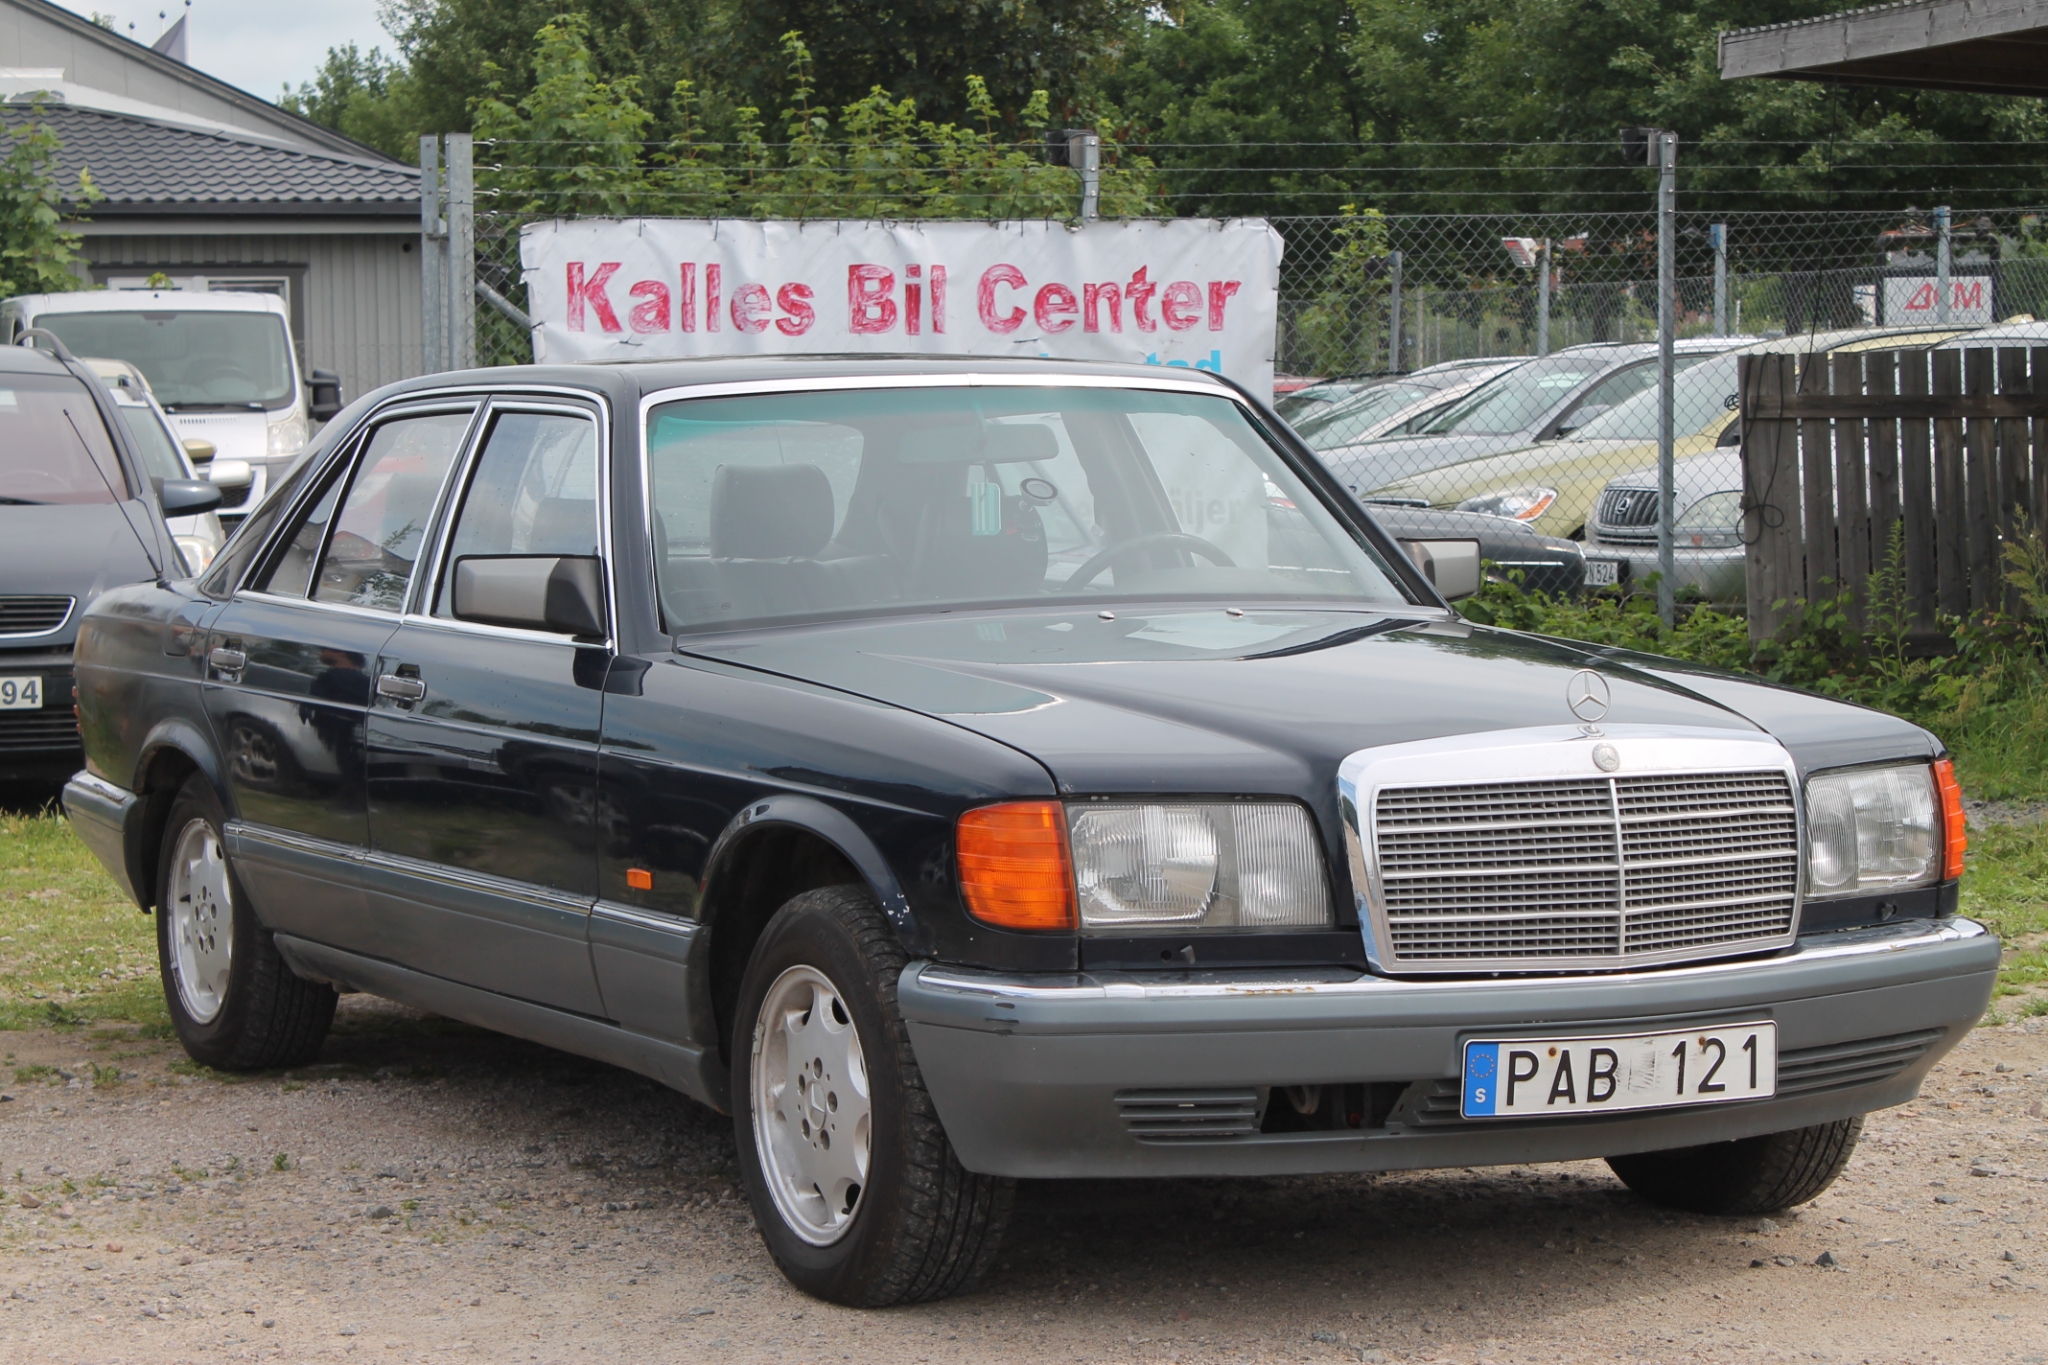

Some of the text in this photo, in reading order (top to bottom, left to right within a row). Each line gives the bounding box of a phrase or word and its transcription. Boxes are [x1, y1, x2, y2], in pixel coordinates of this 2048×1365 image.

[566, 261, 1242, 337] Kalles Bil Center
[1, 679, 39, 705] 94
[1475, 1087, 1487, 1103] S
[1506, 1033, 1758, 1107] PAB 121
